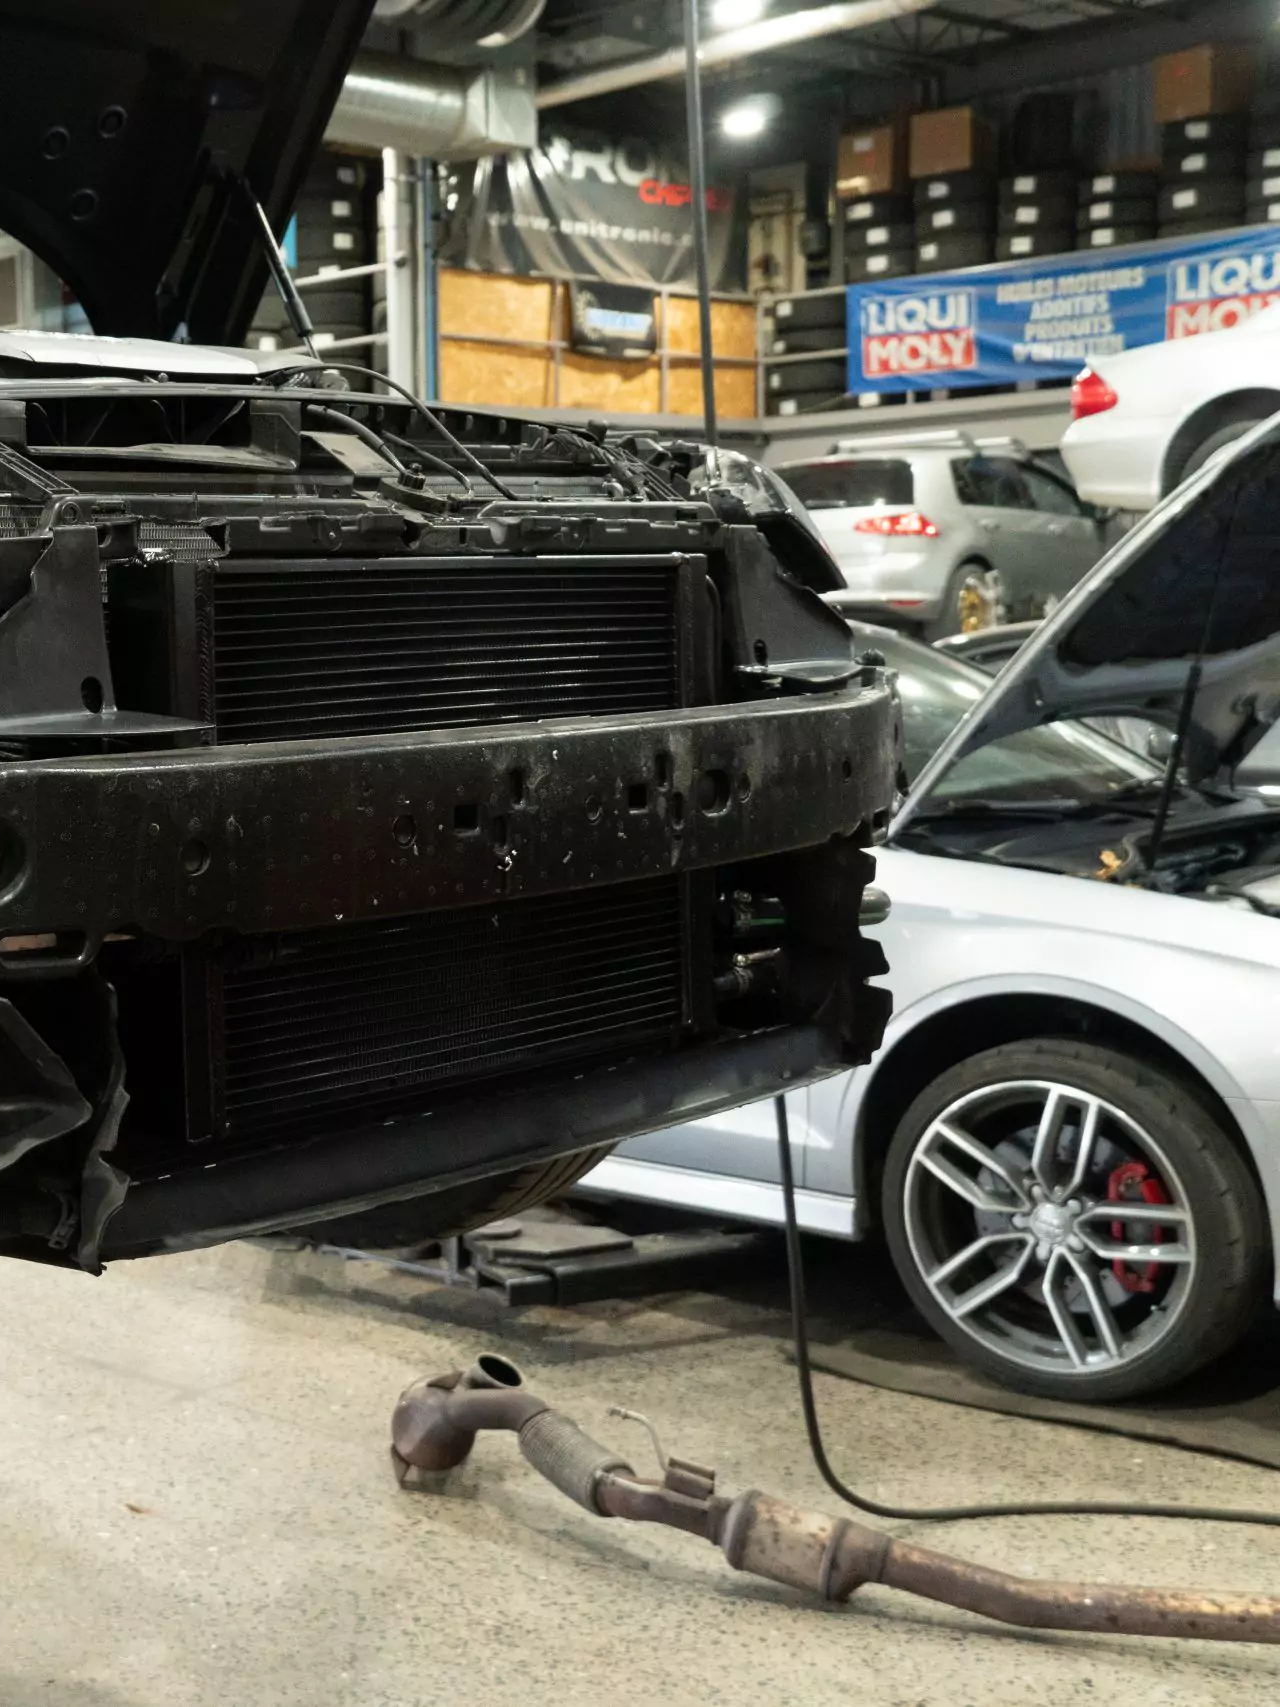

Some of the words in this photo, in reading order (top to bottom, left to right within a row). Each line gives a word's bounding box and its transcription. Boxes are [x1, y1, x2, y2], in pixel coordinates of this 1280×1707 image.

[1175, 252, 1280, 301] LIQU
[866, 293, 969, 334] LIQUI
[869, 332, 969, 372] MOLY
